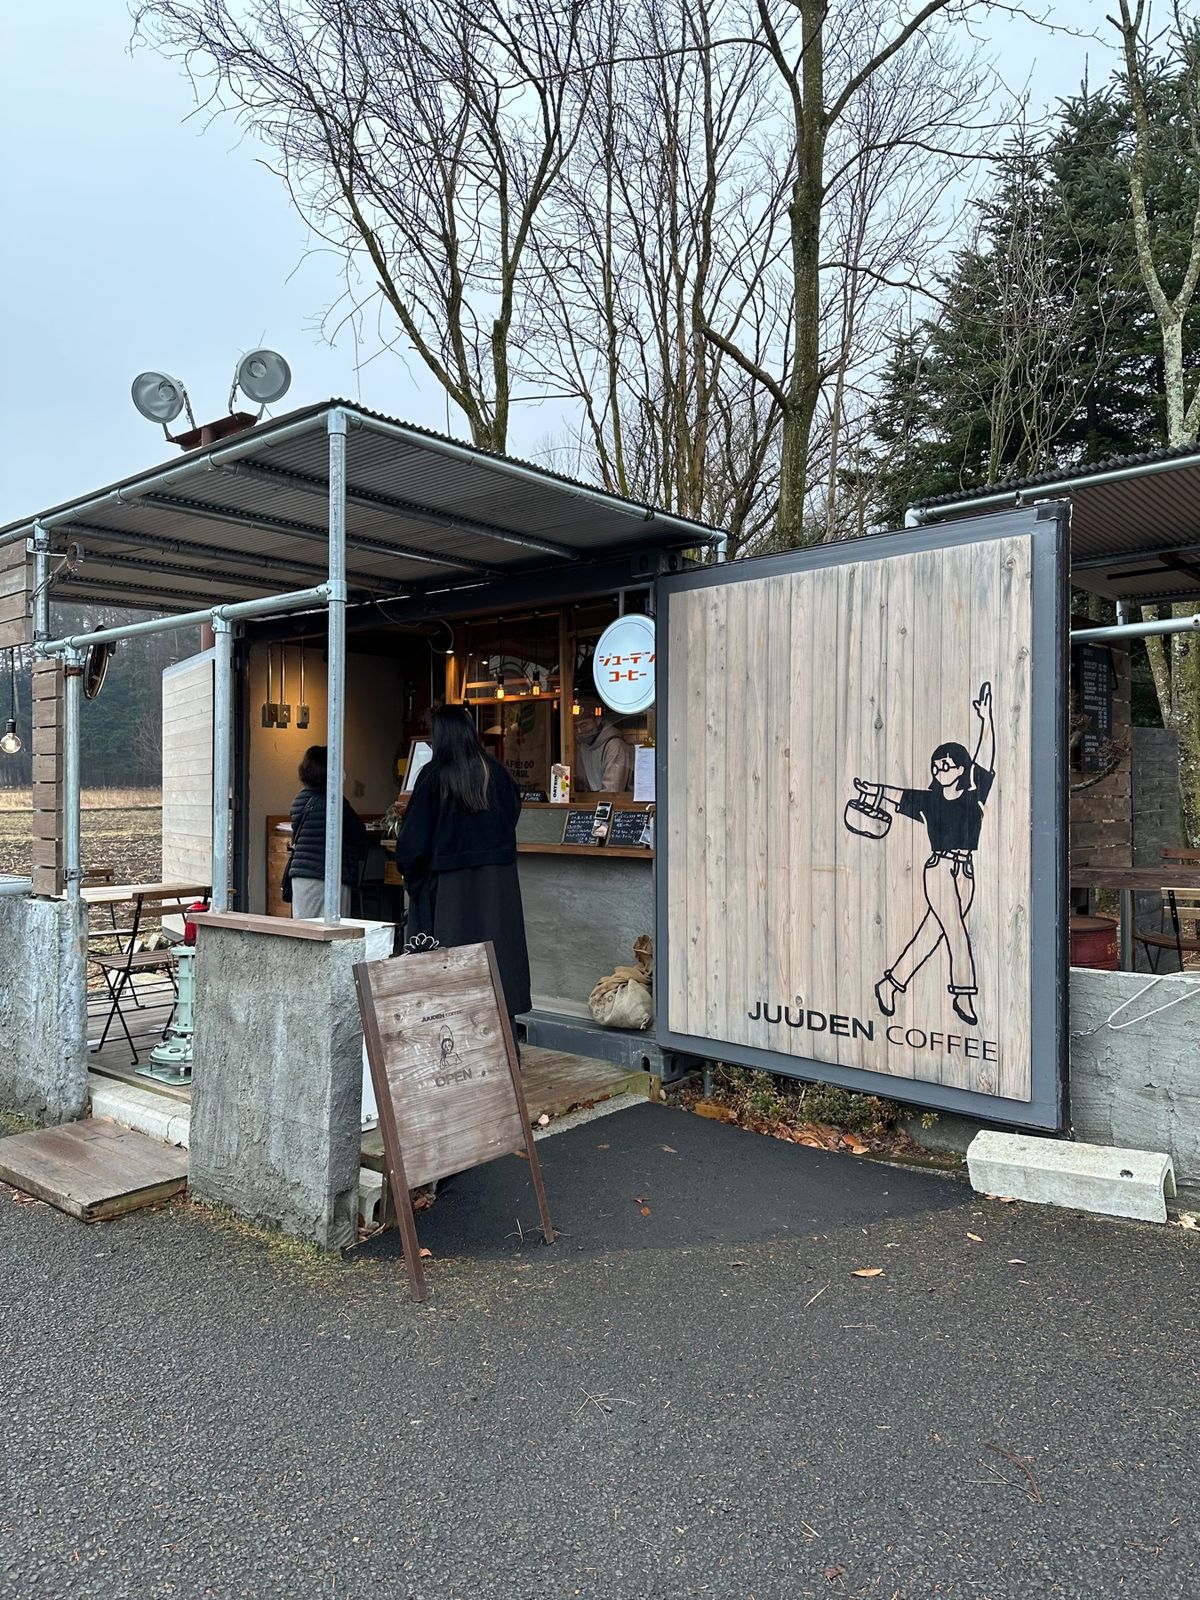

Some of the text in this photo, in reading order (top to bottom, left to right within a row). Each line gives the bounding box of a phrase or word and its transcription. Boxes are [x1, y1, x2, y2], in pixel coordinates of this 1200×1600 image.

[609, 669, 647, 682] コーヒー
[748, 1001, 998, 1062] JUUDEN COFFEE
[435, 1068, 472, 1087] OPEN
